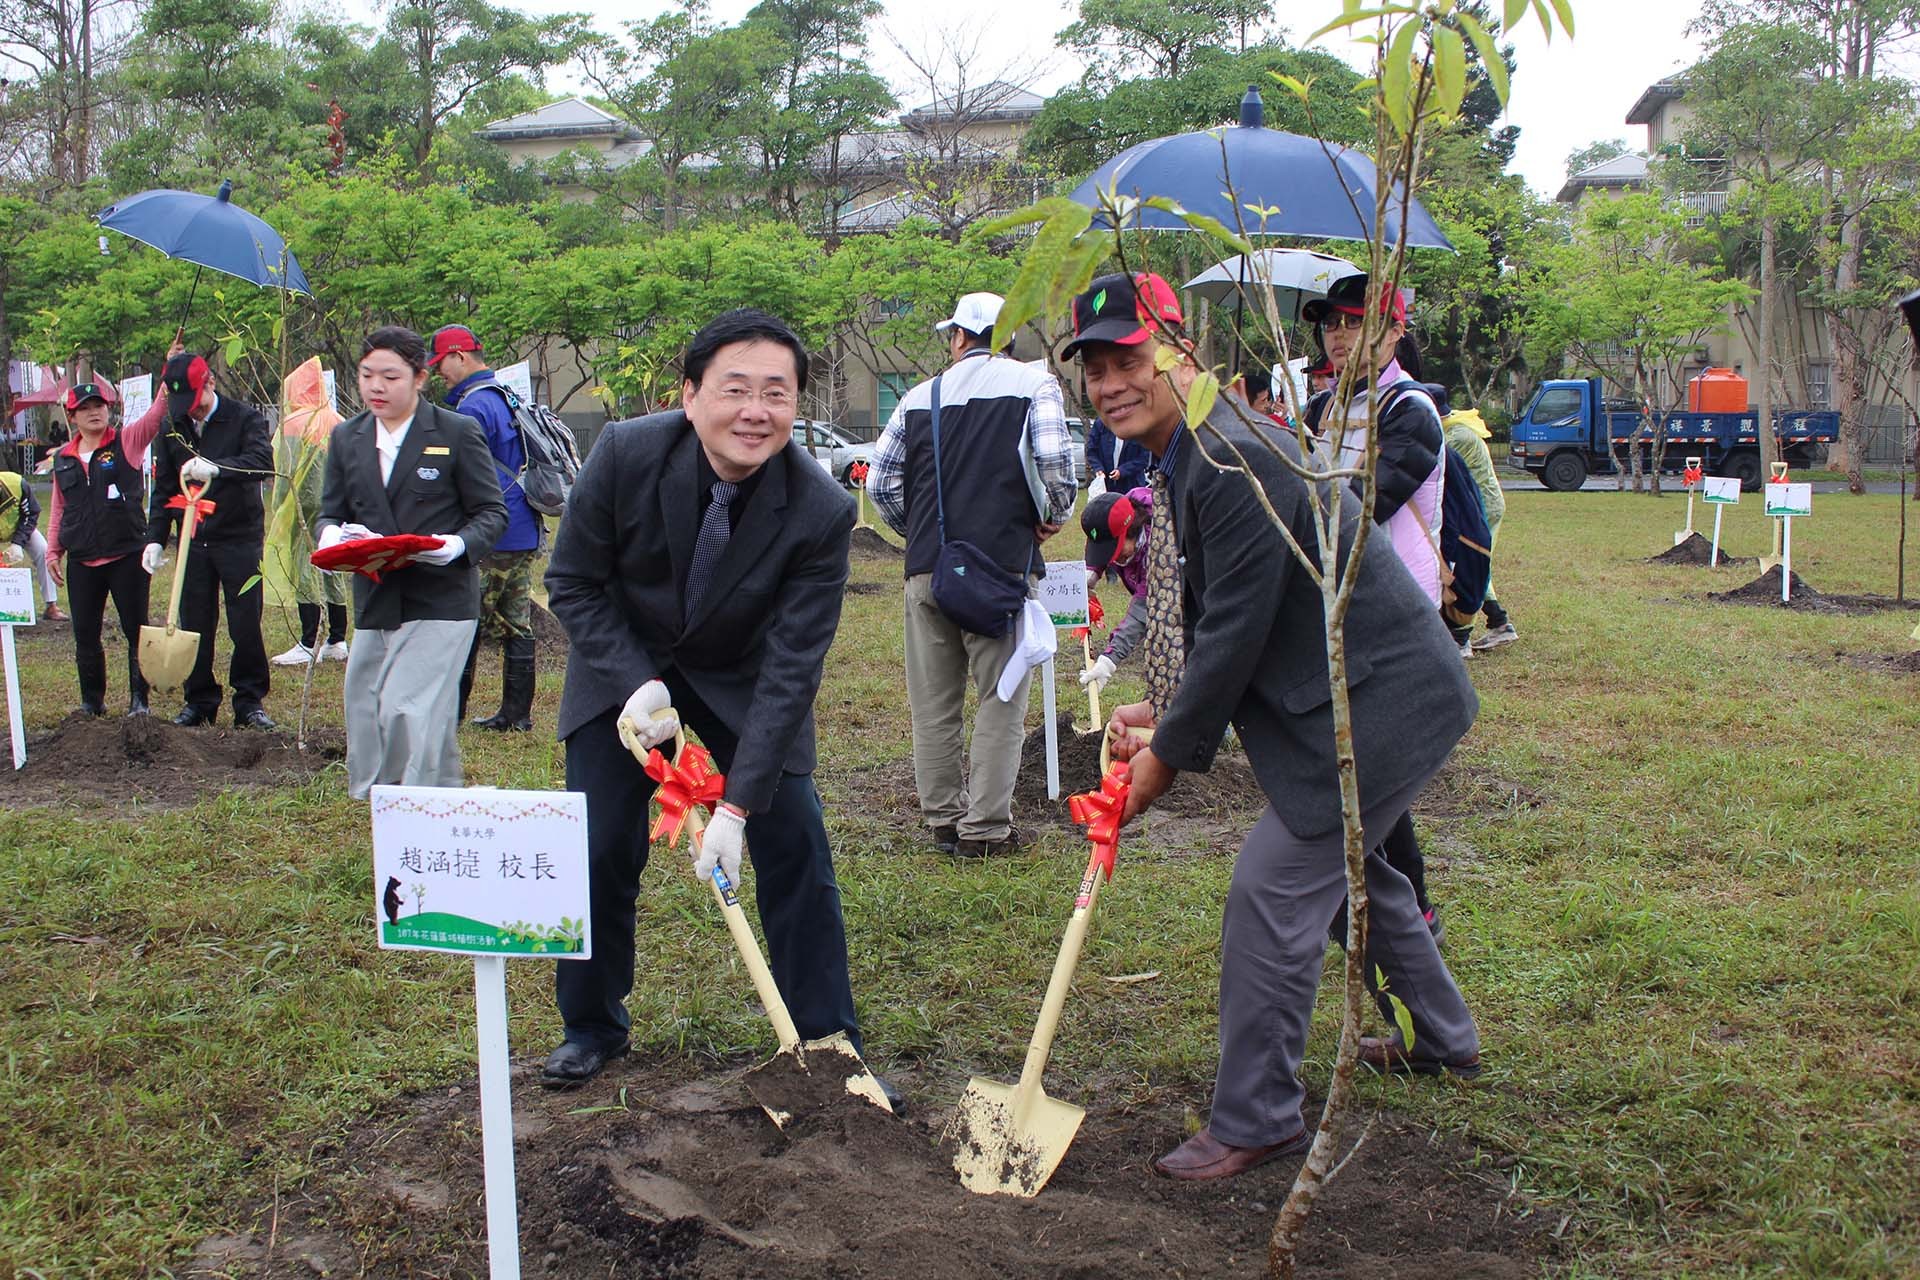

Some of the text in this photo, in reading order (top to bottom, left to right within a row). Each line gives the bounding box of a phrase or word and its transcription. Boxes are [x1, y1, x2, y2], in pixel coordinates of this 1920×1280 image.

[451, 826, 496, 840] 東華大學
[399, 847, 557, 880] 趙涵捷 校長
